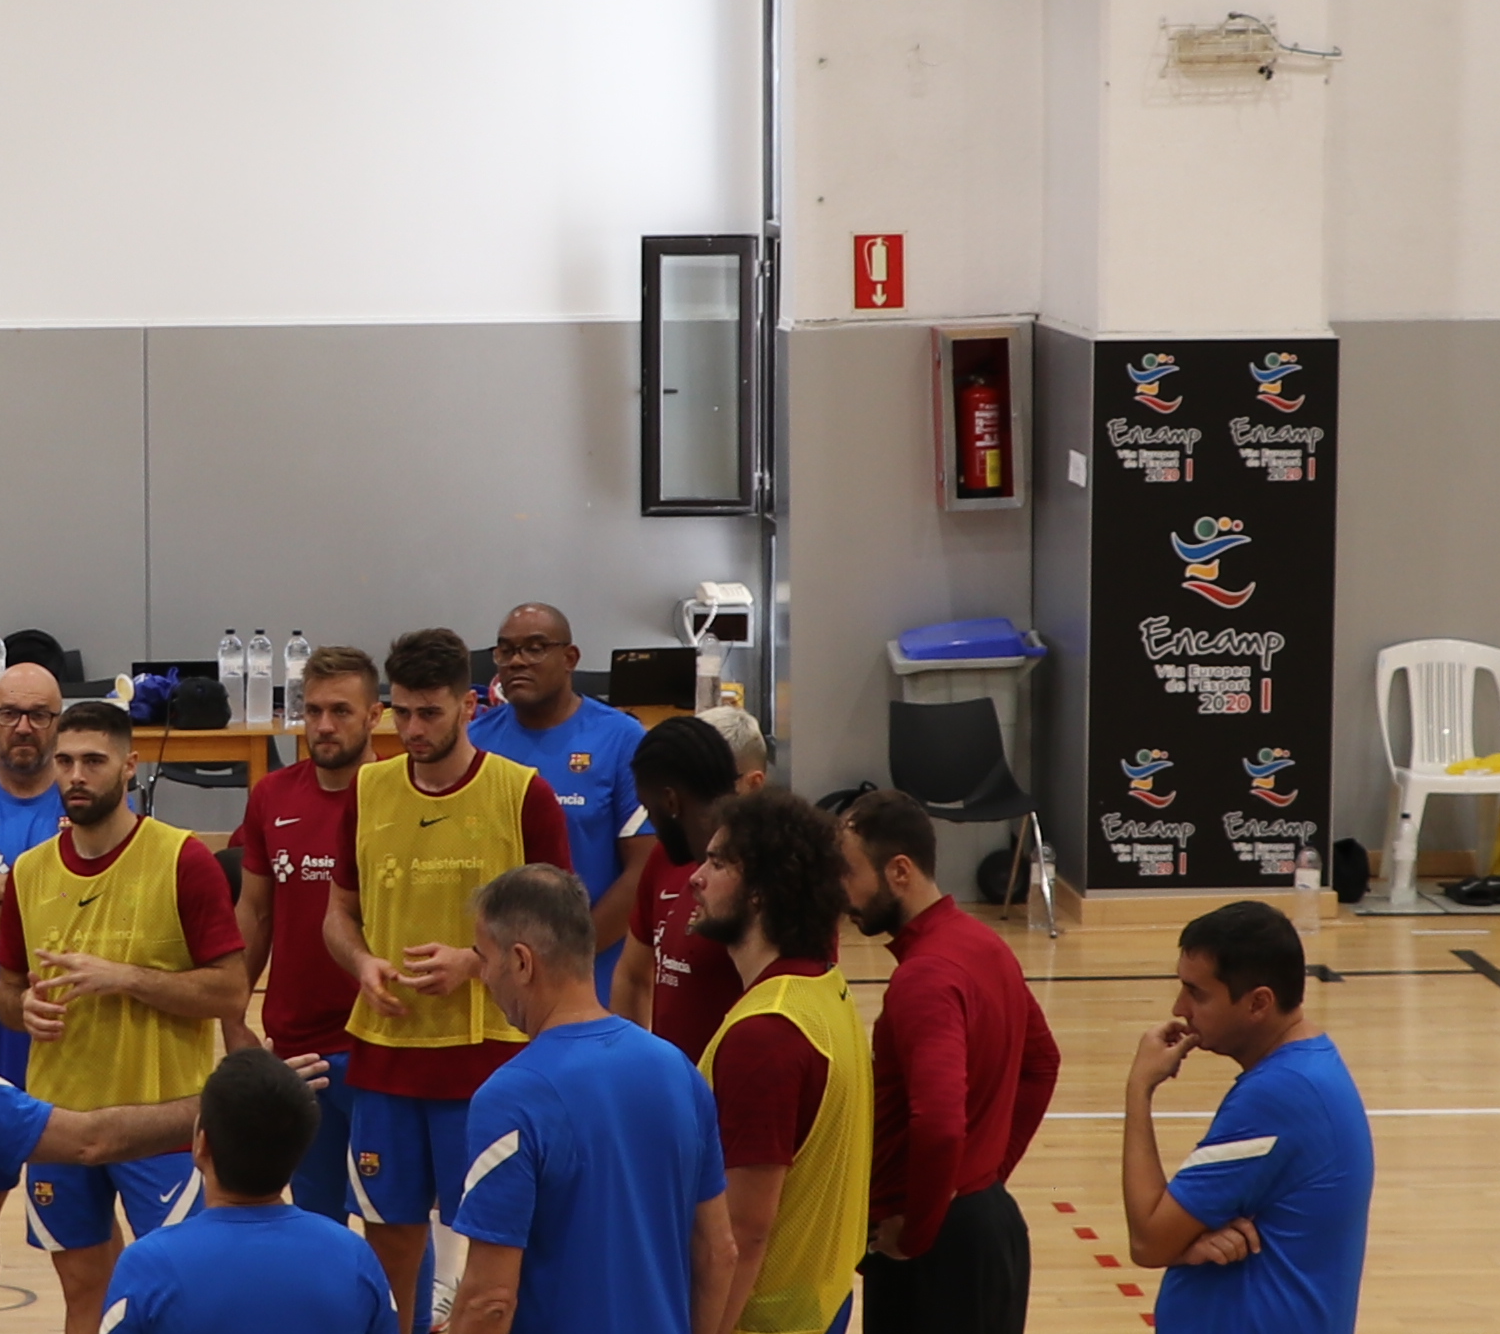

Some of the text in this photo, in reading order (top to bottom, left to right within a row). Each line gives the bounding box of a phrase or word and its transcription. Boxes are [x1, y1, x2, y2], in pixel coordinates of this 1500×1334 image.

[1107, 418, 1202, 454] Encamp
[1229, 417, 1324, 453] Encamp
[1145, 468, 1181, 482] 2020
[1267, 467, 1303, 481] 2020
[1138, 615, 1286, 671] Encamp
[1154, 663, 1252, 679] Vila Europea
[1164, 679, 1187, 693] de
[1198, 693, 1252, 714] 2020
[1100, 812, 1196, 848] Encamp
[1222, 810, 1317, 846] Encamp
[1138, 861, 1175, 876] 2020
[1260, 860, 1297, 874] 2020
